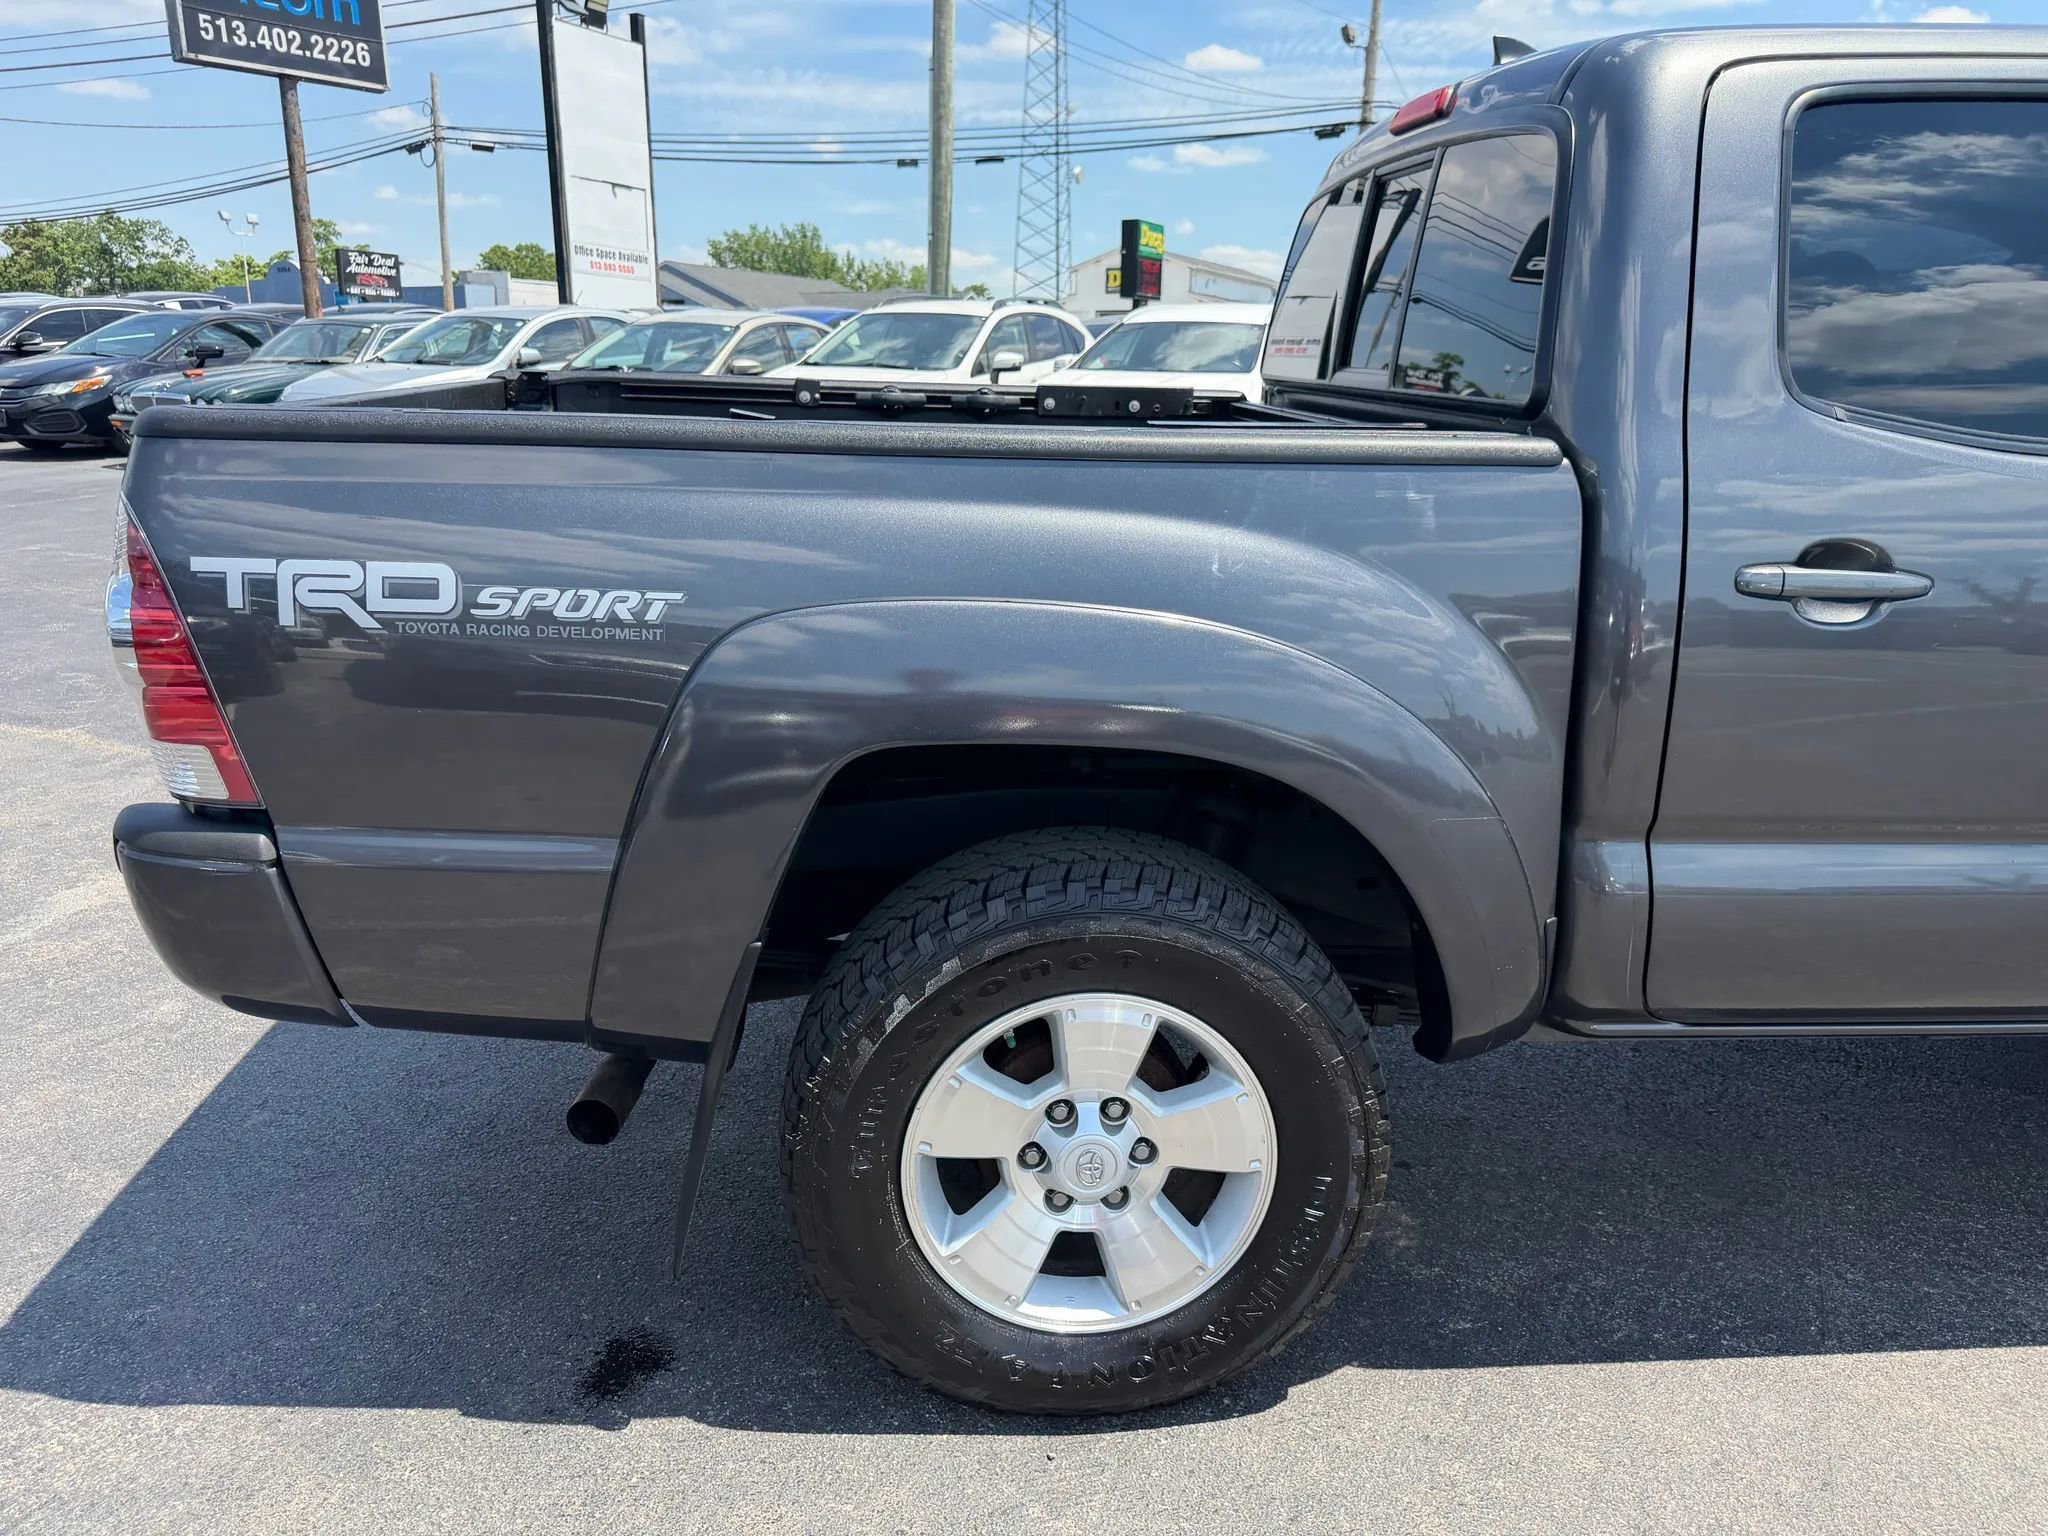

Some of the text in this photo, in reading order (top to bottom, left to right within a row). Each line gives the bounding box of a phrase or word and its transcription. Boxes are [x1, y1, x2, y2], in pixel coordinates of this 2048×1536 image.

[198, 13, 371, 67] 513.402.2226
[348, 252, 395, 267] Fair Deal
[574, 244, 648, 265] Office Space Available
[346, 262, 397, 276] Automotive
[190, 556, 687, 632] TRD SPORT
[395, 621, 664, 641] TOYOTA RACING DEVELOPMENT
